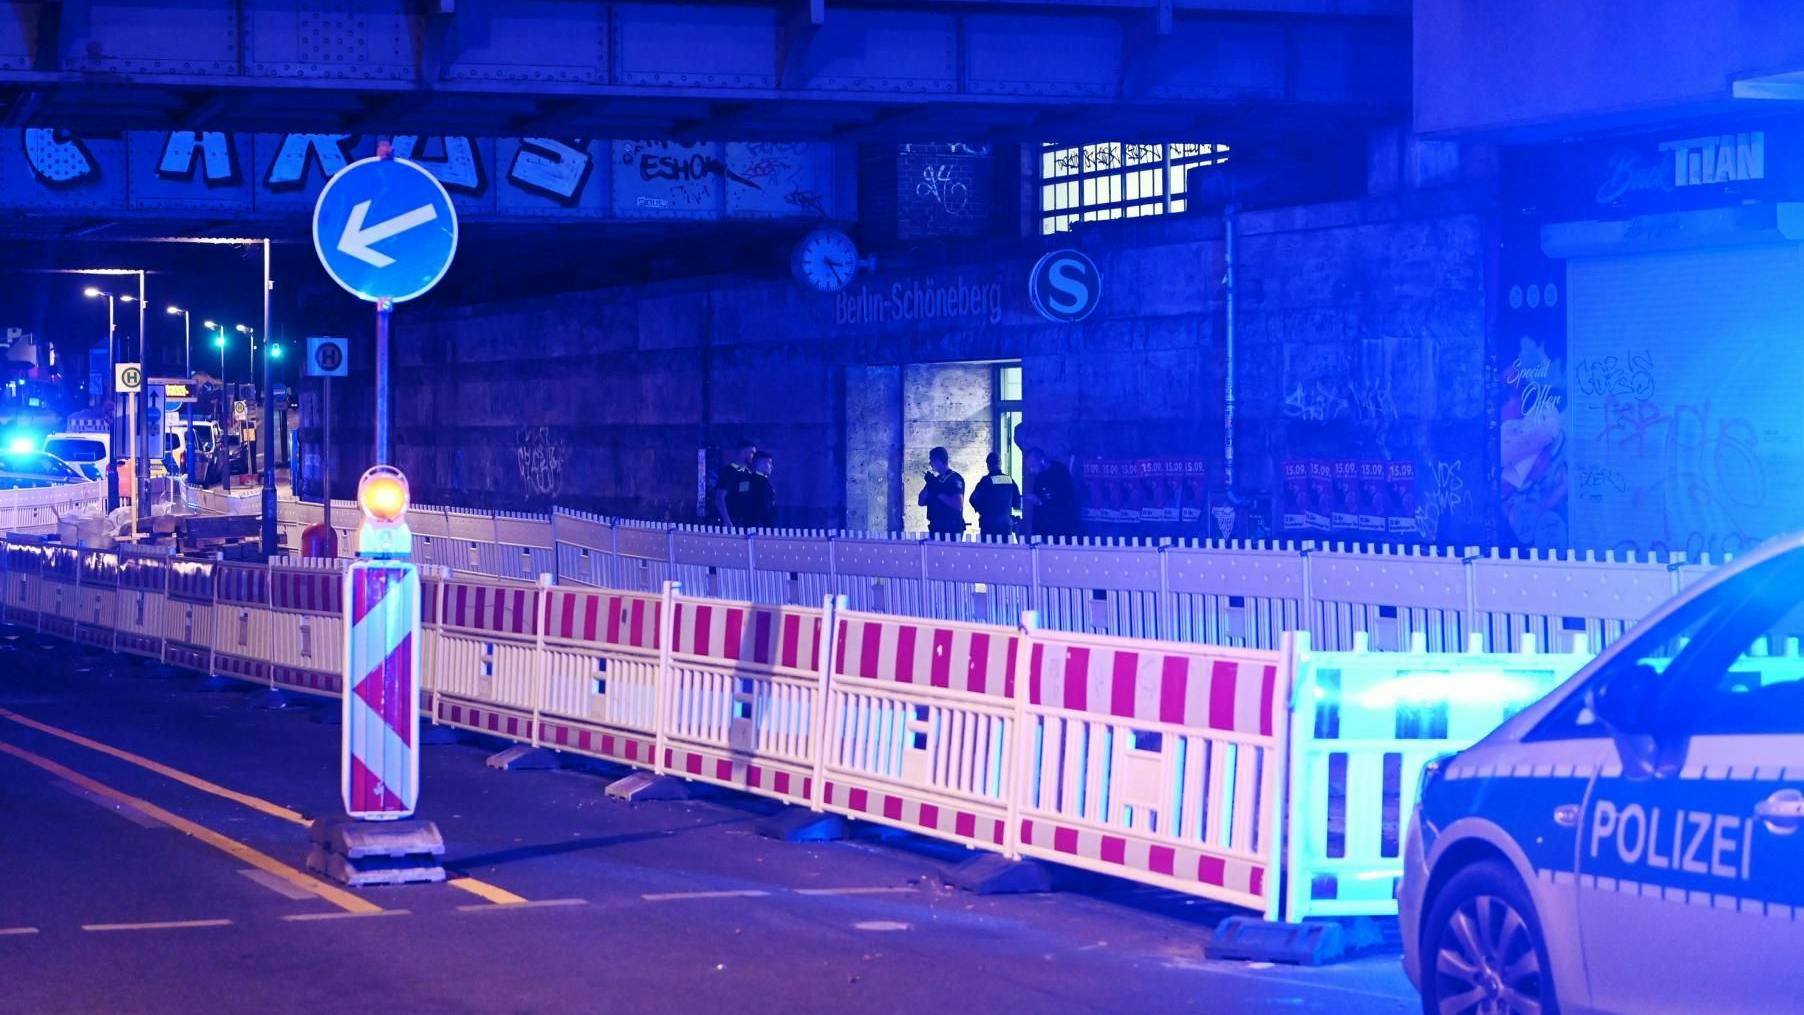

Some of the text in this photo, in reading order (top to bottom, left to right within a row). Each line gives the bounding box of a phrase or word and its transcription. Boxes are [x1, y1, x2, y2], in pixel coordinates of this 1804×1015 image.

[1658, 131, 1764, 187] TITAN
[1048, 258, 1089, 314] S
[836, 274, 1002, 325] Berlin-Schöneberg
[1507, 358, 1552, 389] Special
[1521, 381, 1561, 424] Offer
[1185, 462, 1205, 473] 15.09.
[1286, 464, 1307, 476] 15.09.
[1311, 463, 1332, 478] 15.09.
[1334, 463, 1357, 475] 15.09.
[1361, 464, 1384, 476] 15.09.
[1390, 464, 1414, 477] 15.09.
[1589, 798, 1754, 880] POLIZEI
